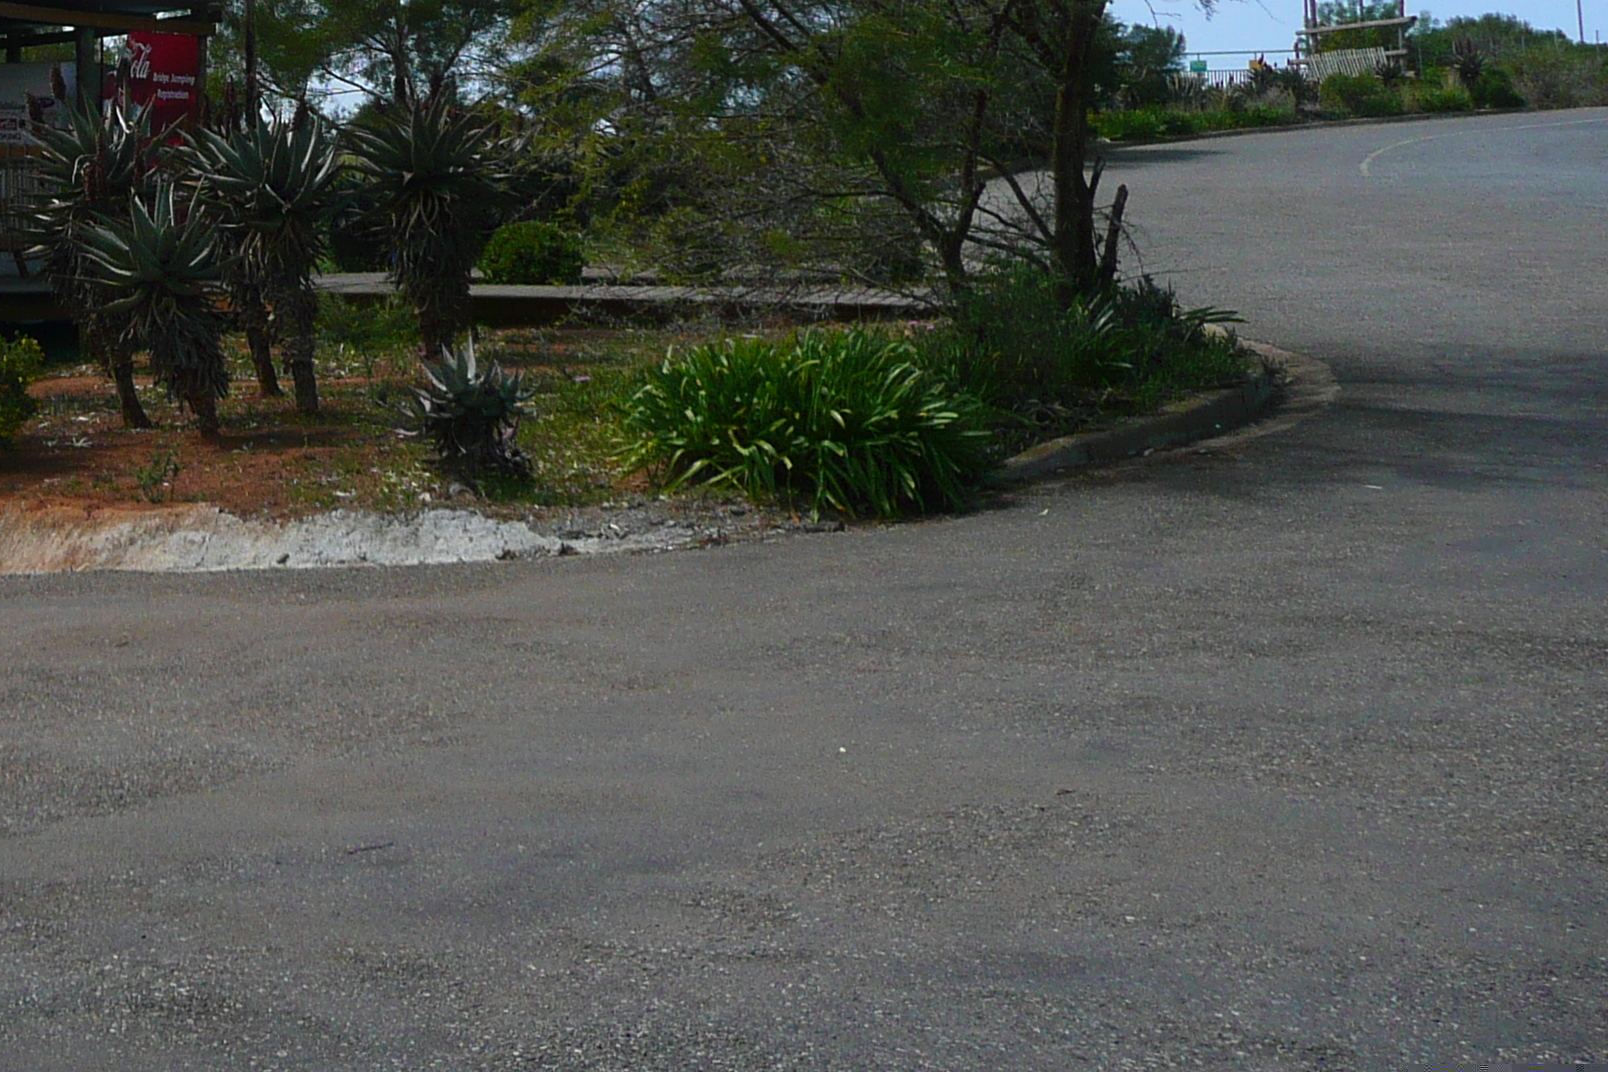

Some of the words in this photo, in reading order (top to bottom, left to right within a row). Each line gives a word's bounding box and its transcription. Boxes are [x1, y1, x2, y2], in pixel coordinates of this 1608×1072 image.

[152, 72, 170, 85] Bridge
[171, 73, 195, 86] Jumping
[157, 88, 189, 101] Registration
